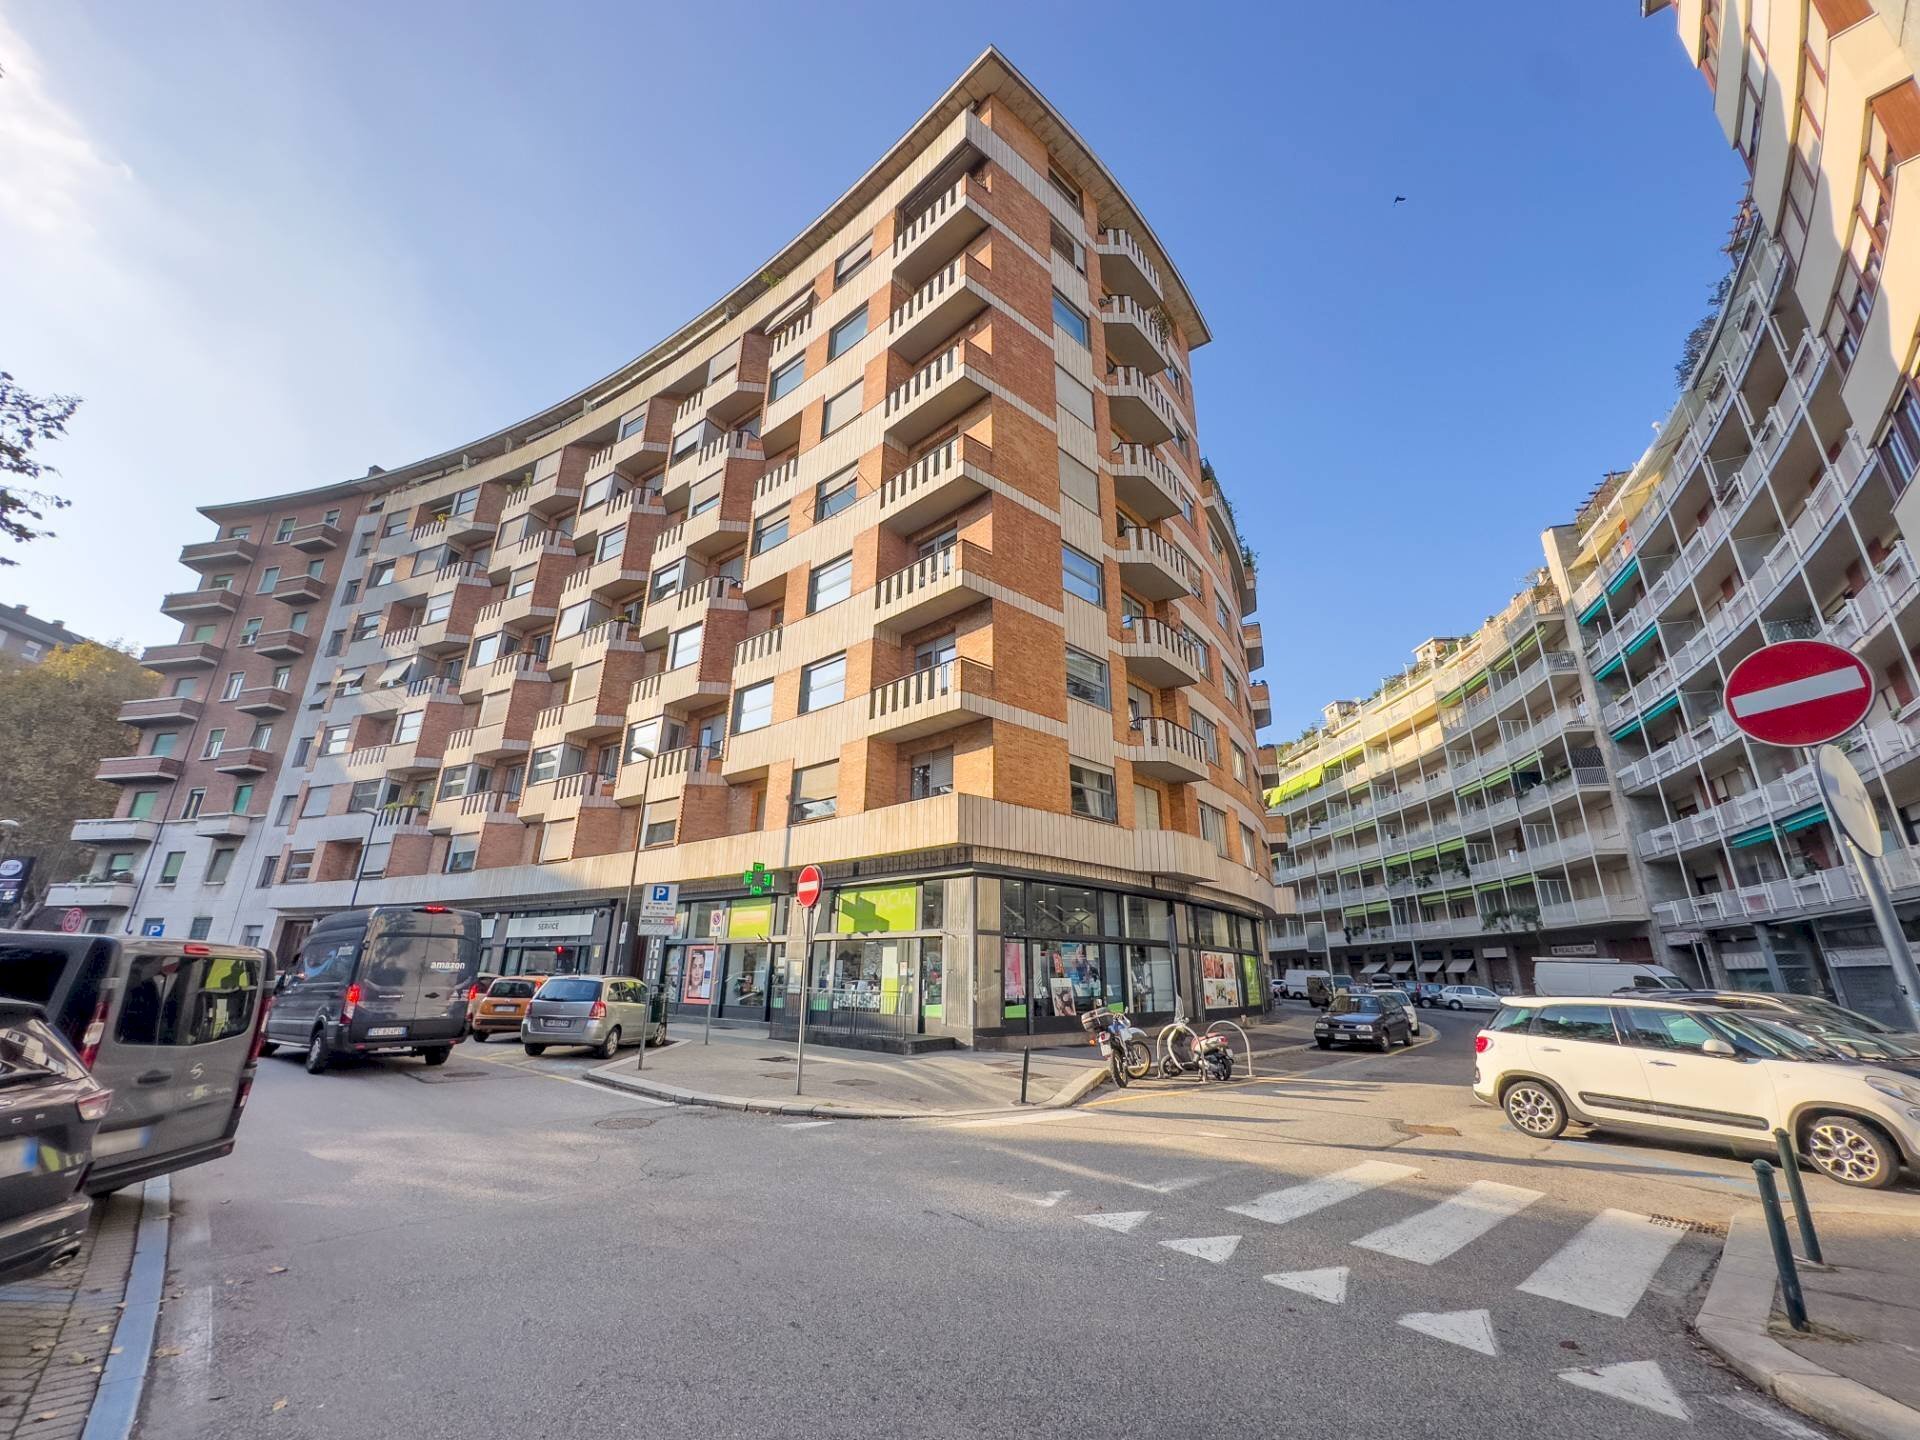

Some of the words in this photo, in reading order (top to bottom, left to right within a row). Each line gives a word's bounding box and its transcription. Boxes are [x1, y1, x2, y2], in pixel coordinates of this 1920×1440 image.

[654, 887, 667, 900] P
[148, 925, 161, 936] P
[537, 922, 560, 931] SERVICE
[430, 961, 466, 970] amazon
